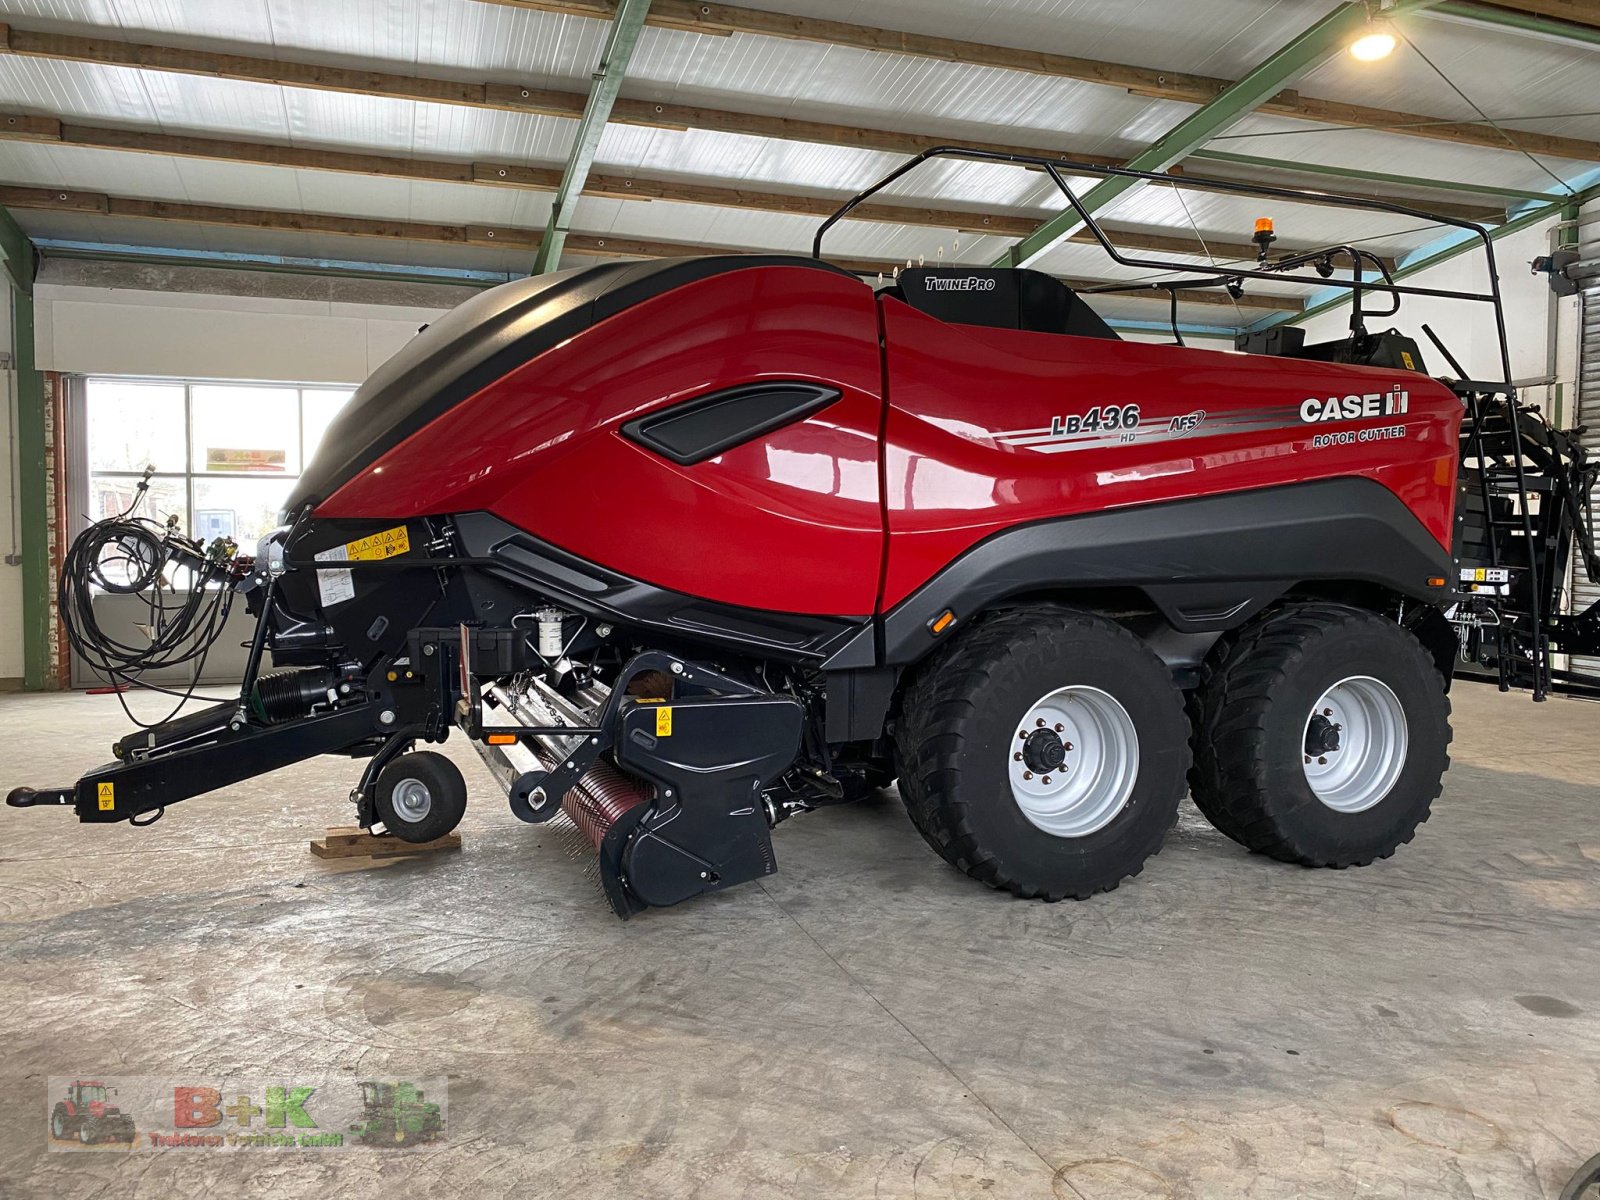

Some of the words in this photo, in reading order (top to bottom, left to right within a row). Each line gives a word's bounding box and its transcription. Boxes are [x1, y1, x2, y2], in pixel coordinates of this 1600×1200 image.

[1299, 393, 1381, 423] CASE
[1050, 403, 1141, 437] LB436
[1167, 413, 1199, 434] AFS
[1120, 432, 1136, 443] HD
[1313, 430, 1356, 448] ROTOR
[1357, 425, 1406, 442] CUTTER
